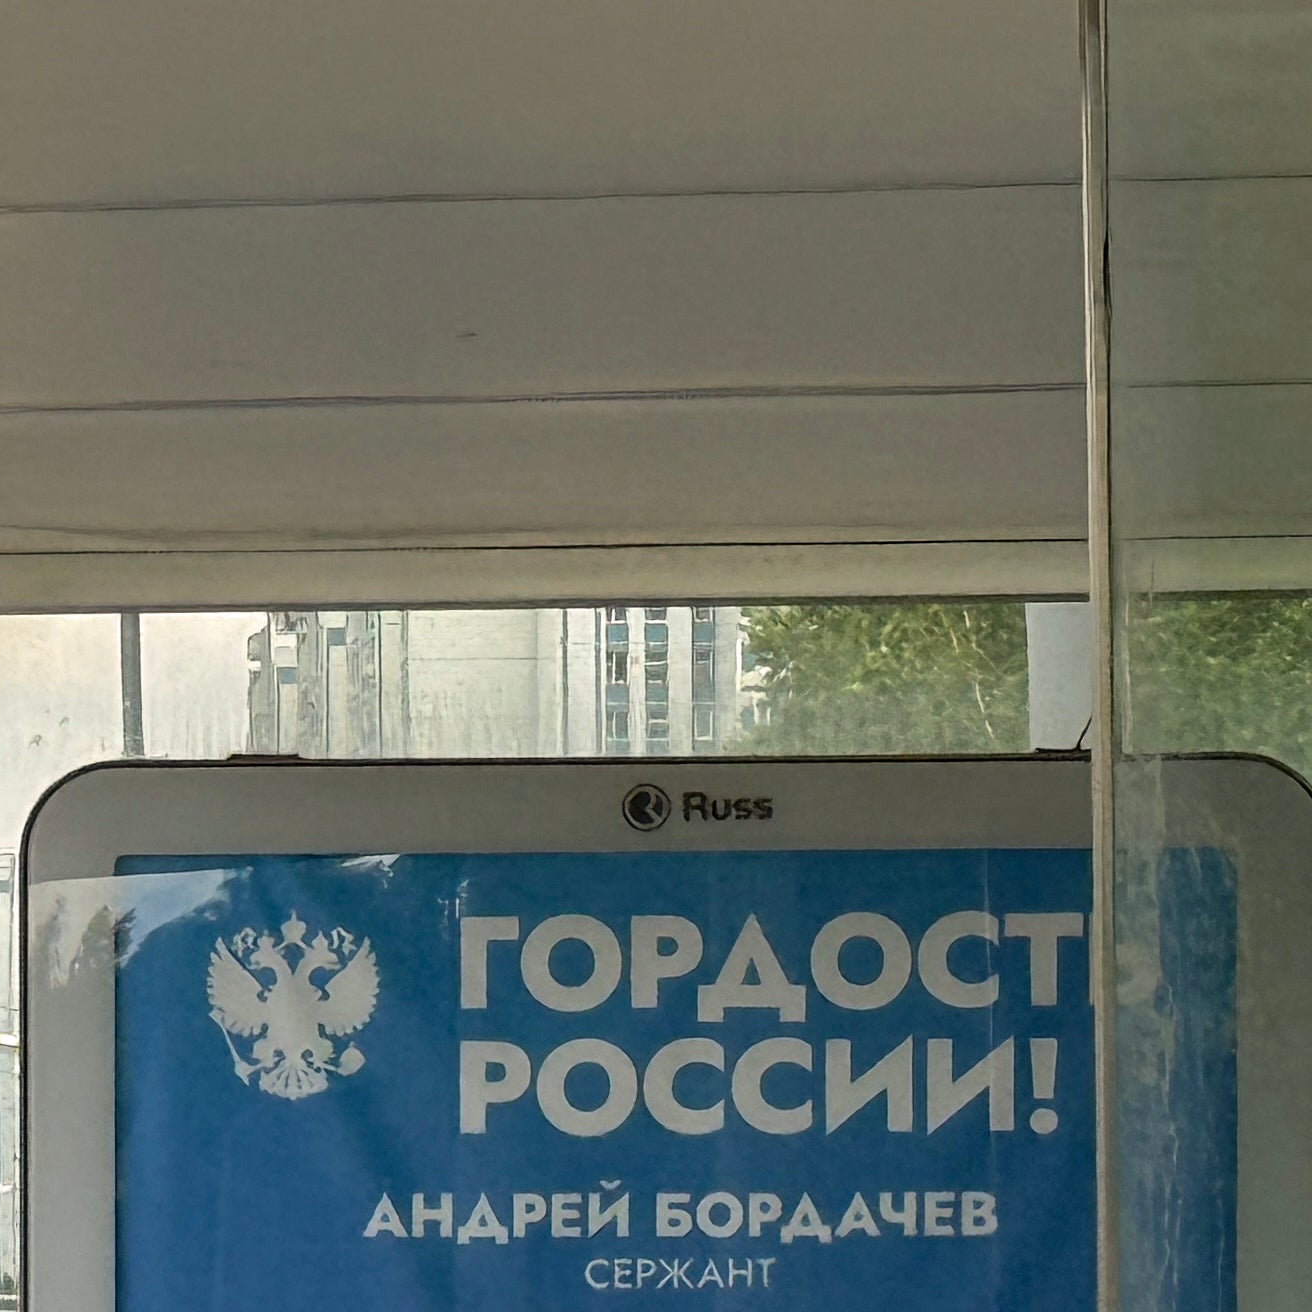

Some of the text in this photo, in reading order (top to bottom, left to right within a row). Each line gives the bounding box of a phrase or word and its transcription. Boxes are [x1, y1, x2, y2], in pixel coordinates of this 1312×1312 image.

[682, 791, 774, 823] Russ
[459, 1035, 1060, 1137] РОССИИ!
[363, 1180, 999, 1246] АНДРЕЙ БОРДАЧЕВ
[585, 1258, 777, 1290] СЕРЖАНТ
